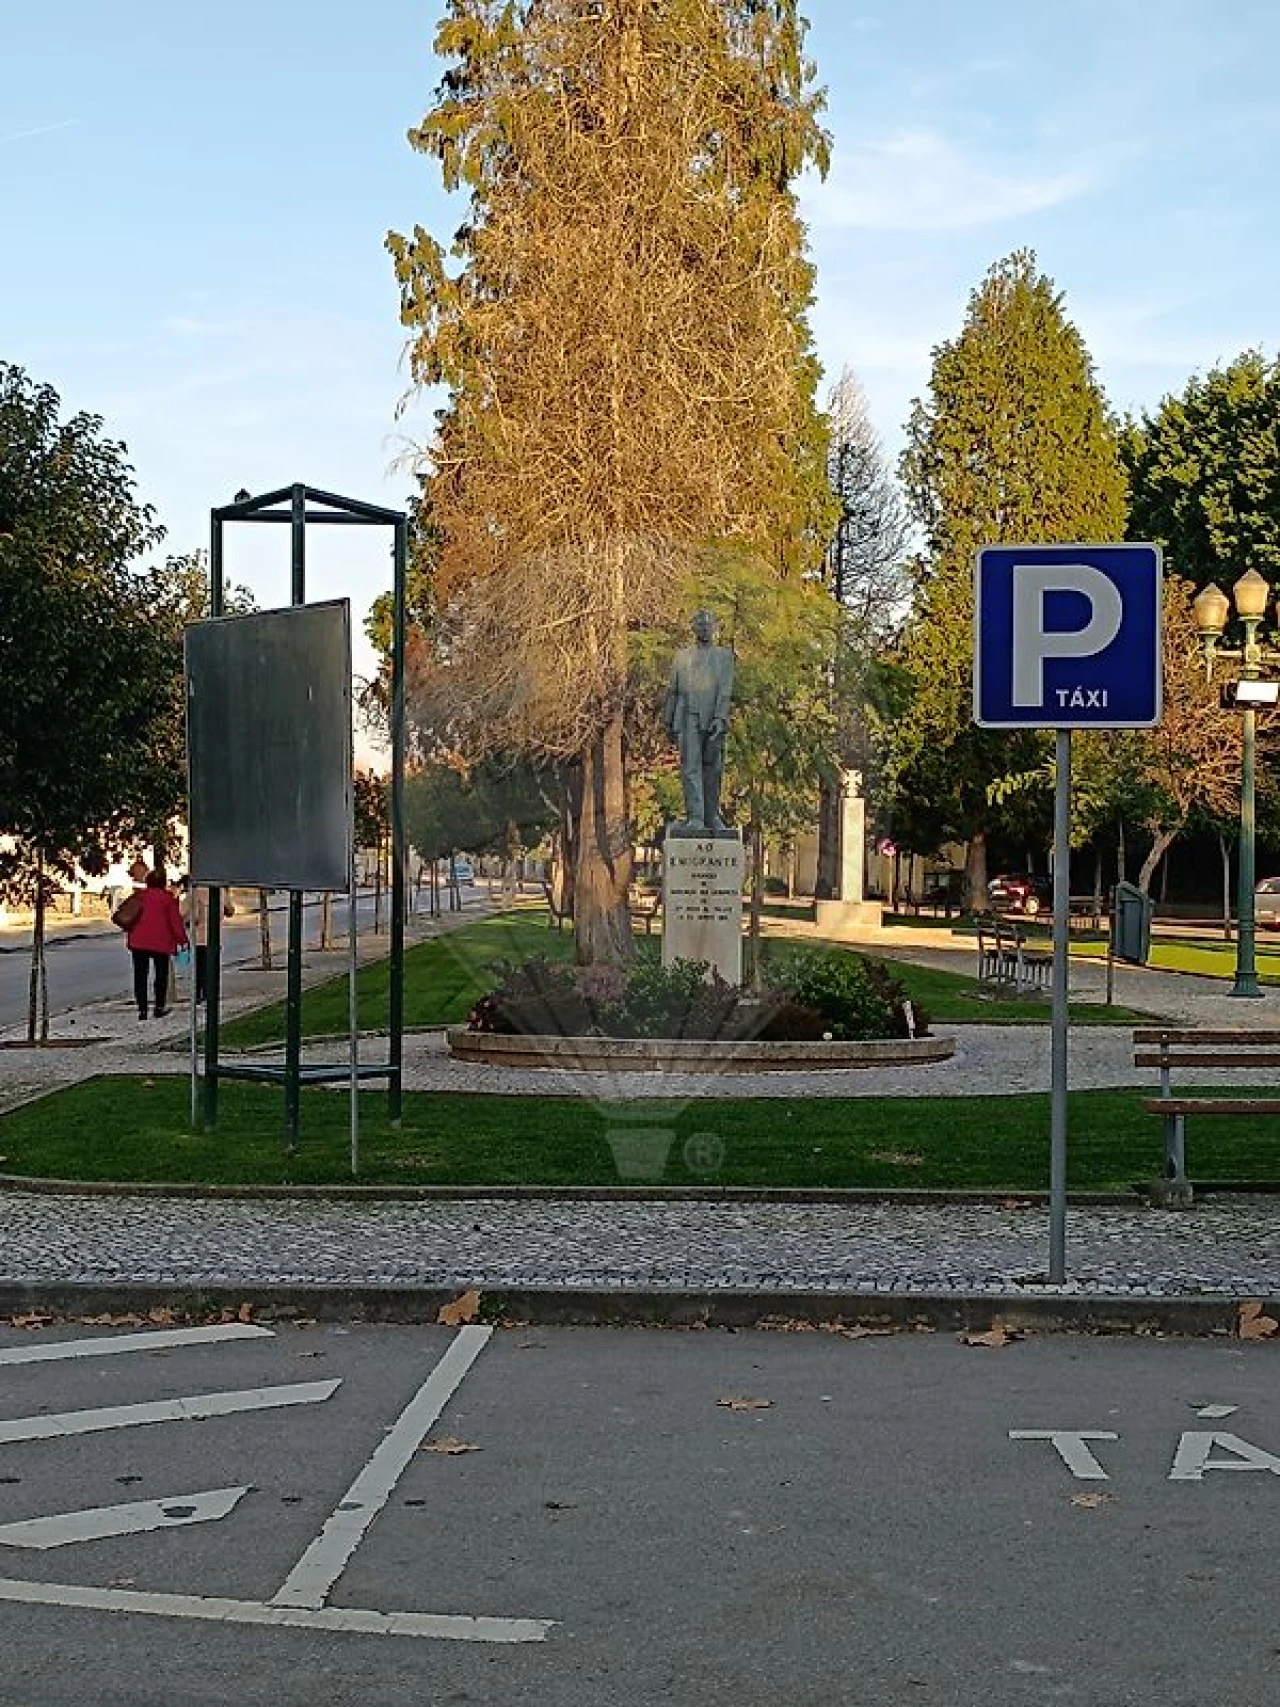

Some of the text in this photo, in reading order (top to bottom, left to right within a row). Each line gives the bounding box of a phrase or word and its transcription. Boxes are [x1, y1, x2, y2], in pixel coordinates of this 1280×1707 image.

[1011, 564, 1123, 707] P
[1055, 684, 1108, 708] TÁXI
[1008, 1403, 1280, 1480] TÁ
